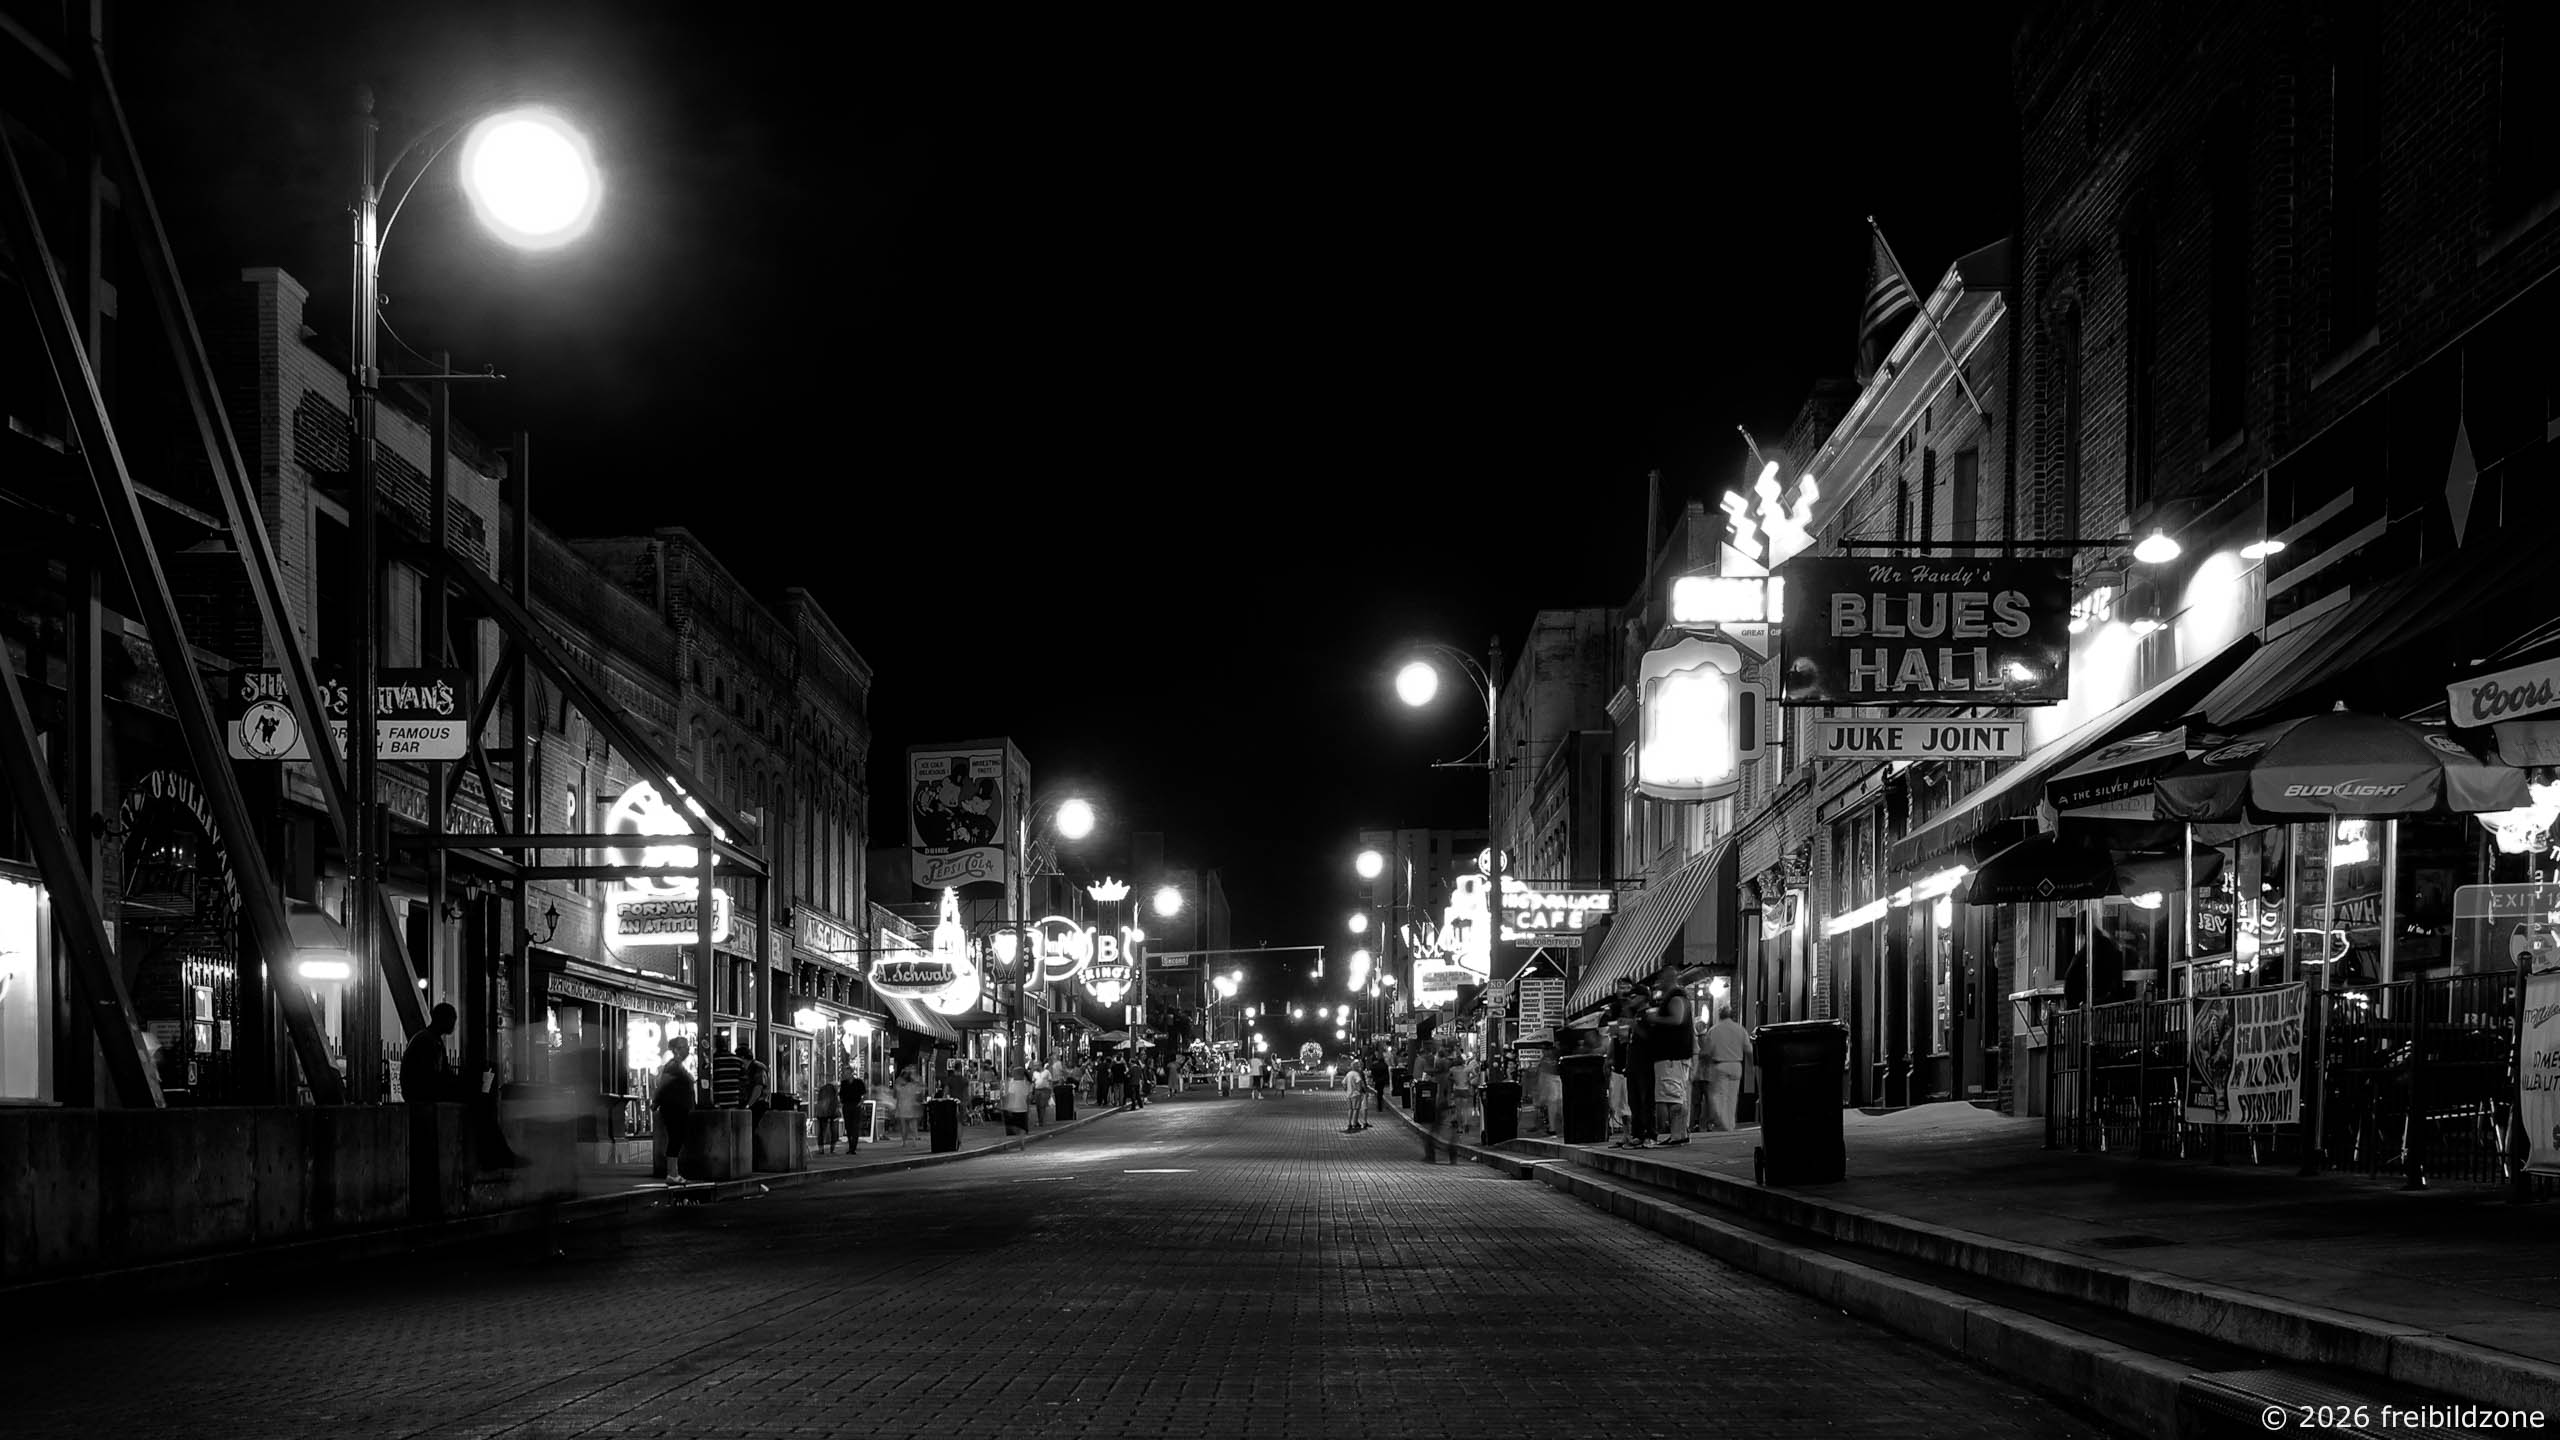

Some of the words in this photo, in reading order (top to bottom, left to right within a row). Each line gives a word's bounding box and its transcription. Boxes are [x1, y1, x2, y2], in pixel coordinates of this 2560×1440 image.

[1869, 564, 1902, 583] Mr
[1911, 565, 1991, 586] Handy's
[1831, 590, 2031, 638] BLUES
[1849, 647, 2005, 692] HALL
[2472, 678, 2554, 720] Coors
[389, 727, 450, 739] FAMOUS
[1829, 727, 1903, 751] JUKE
[1922, 726, 2010, 751] JOINT
[390, 741, 420, 753] BAR
[2073, 790, 2091, 801] THE
[2095, 782, 2129, 797] SILVER
[2284, 784, 2333, 796] BUD
[2342, 783, 2405, 797] LIGHT
[924, 847, 950, 855] DRINK
[2493, 894, 2536, 908] EXIT
[618, 919, 640, 935] AN
[1163, 955, 1187, 965] Second
[893, 962, 954, 983] Schwab
